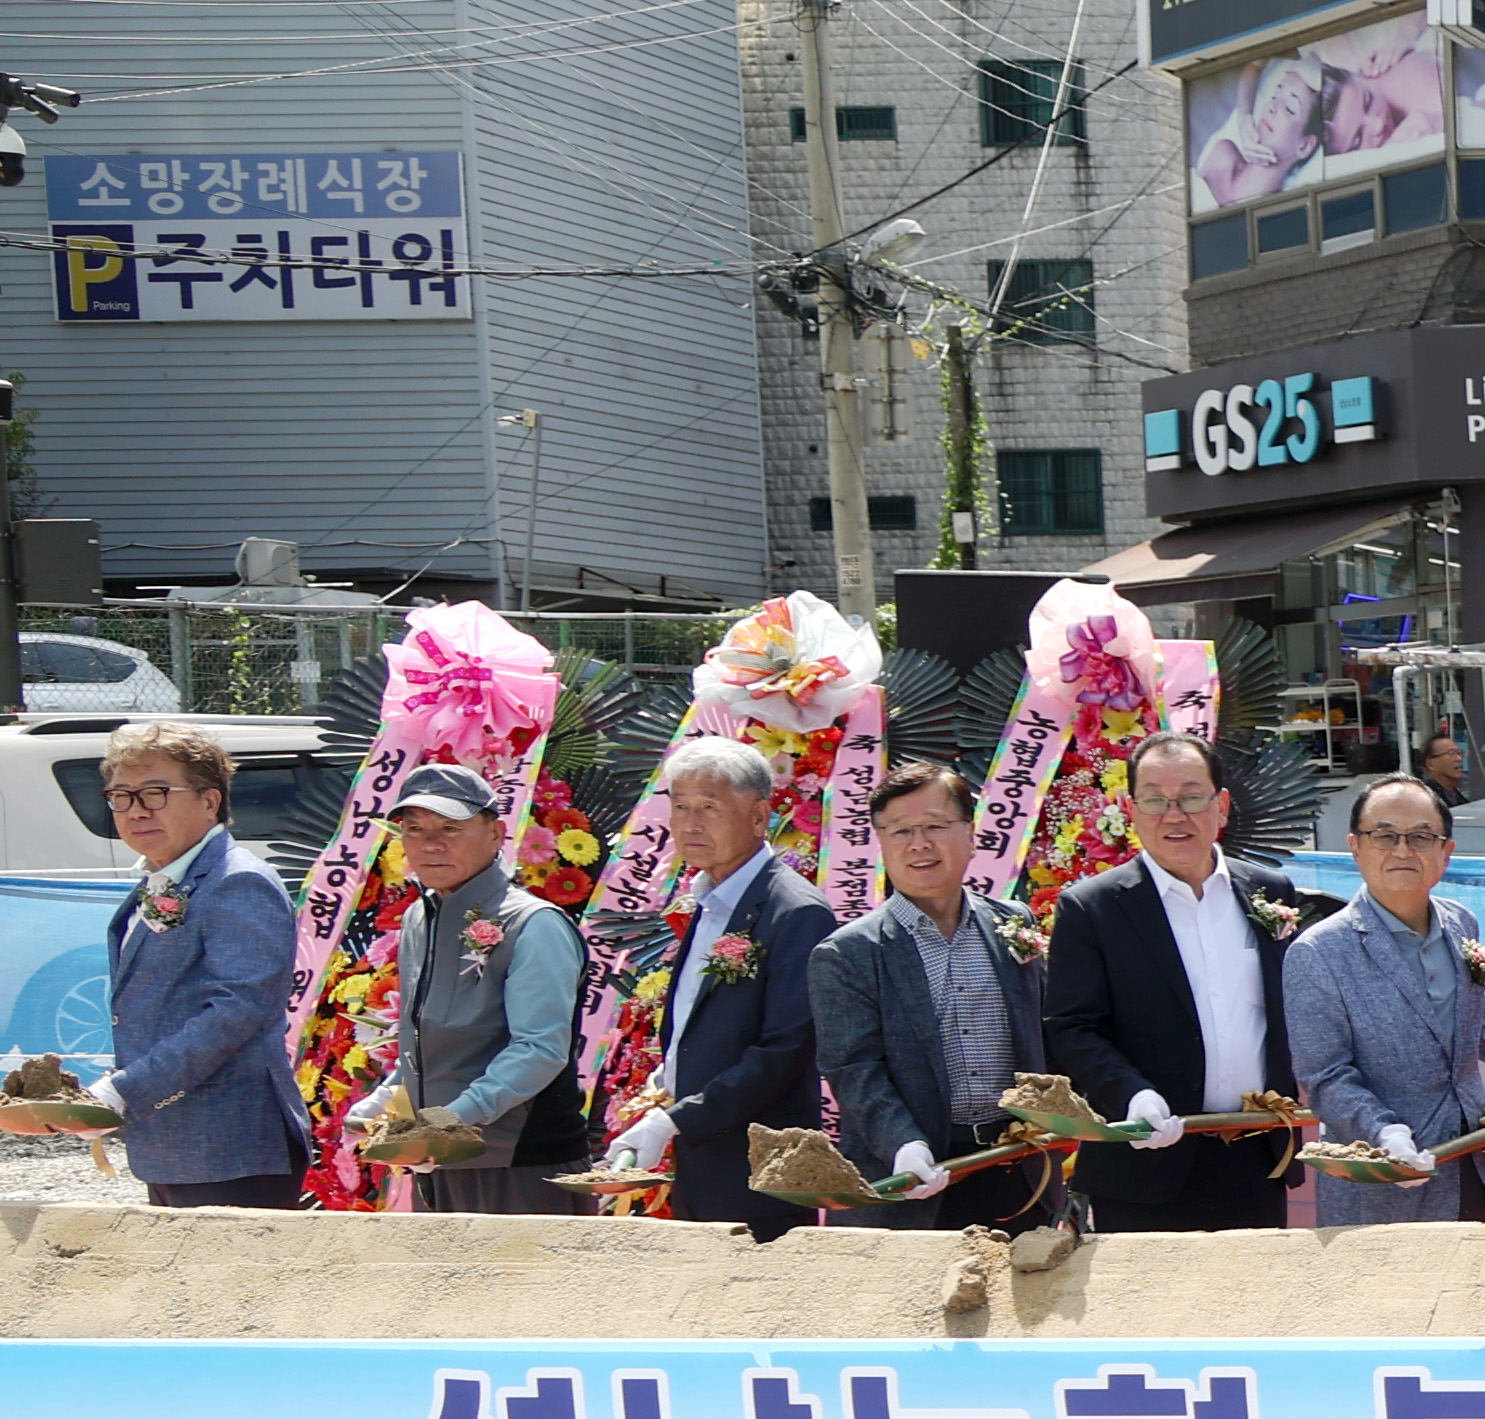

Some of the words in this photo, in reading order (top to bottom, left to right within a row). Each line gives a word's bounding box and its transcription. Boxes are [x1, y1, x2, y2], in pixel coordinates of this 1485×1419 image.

[77, 157, 428, 216] 소망장례식장
[66, 234, 124, 313] P
[93, 300, 132, 313] Parking
[147, 228, 458, 310] 주차타워
[1192, 372, 1321, 477] GS25
[974, 709, 1060, 860] 농협중앙회
[307, 748, 407, 940] 성남농협
